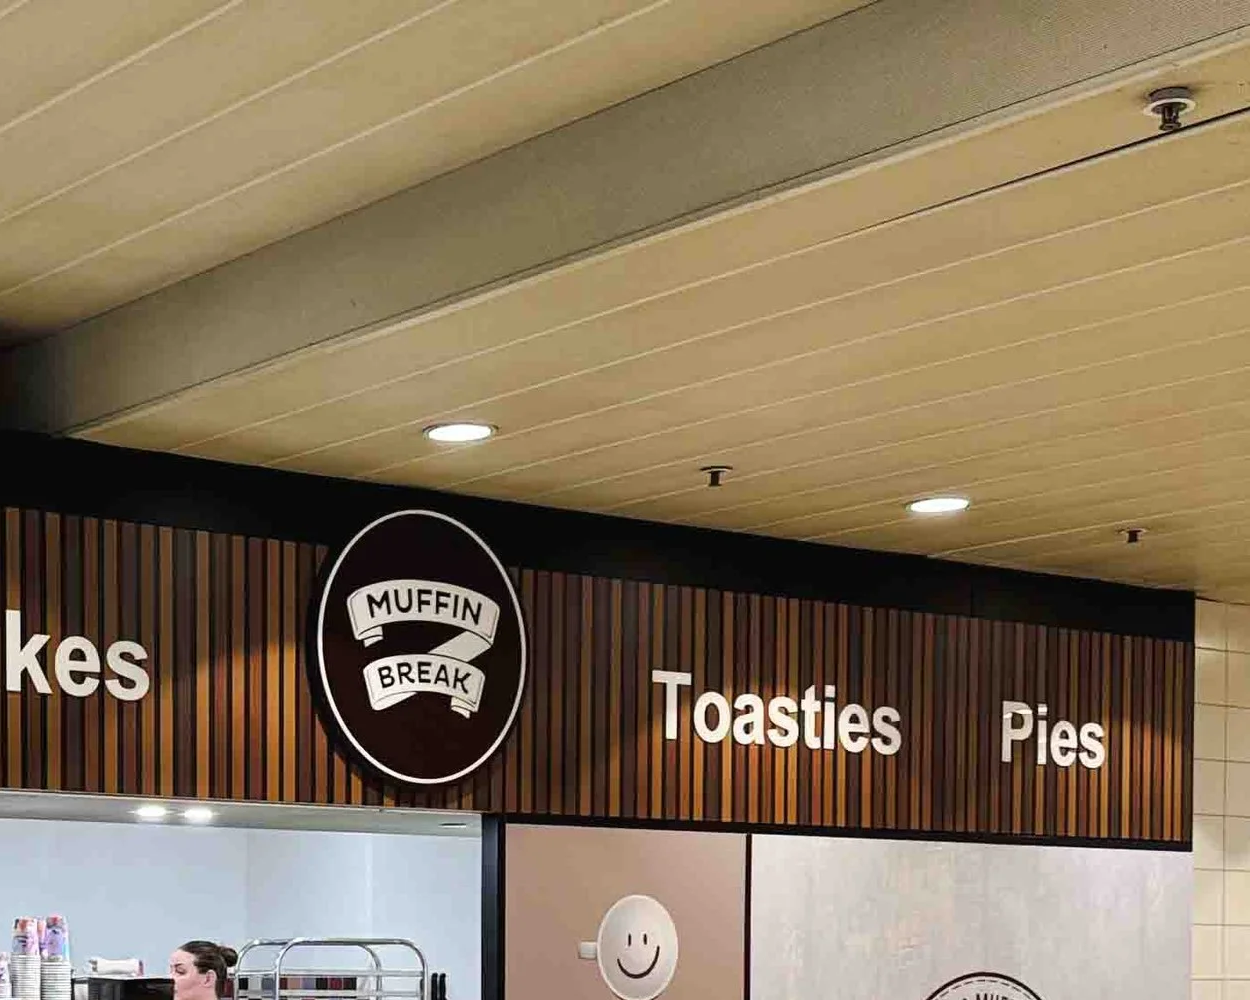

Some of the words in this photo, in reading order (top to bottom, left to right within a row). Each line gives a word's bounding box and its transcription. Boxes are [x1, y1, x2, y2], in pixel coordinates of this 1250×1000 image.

[366, 588, 483, 625] MUFFIN
[377, 661, 473, 695] BREAK
[652, 669, 902, 756] Toasties
[1000, 700, 1106, 769] Pies
